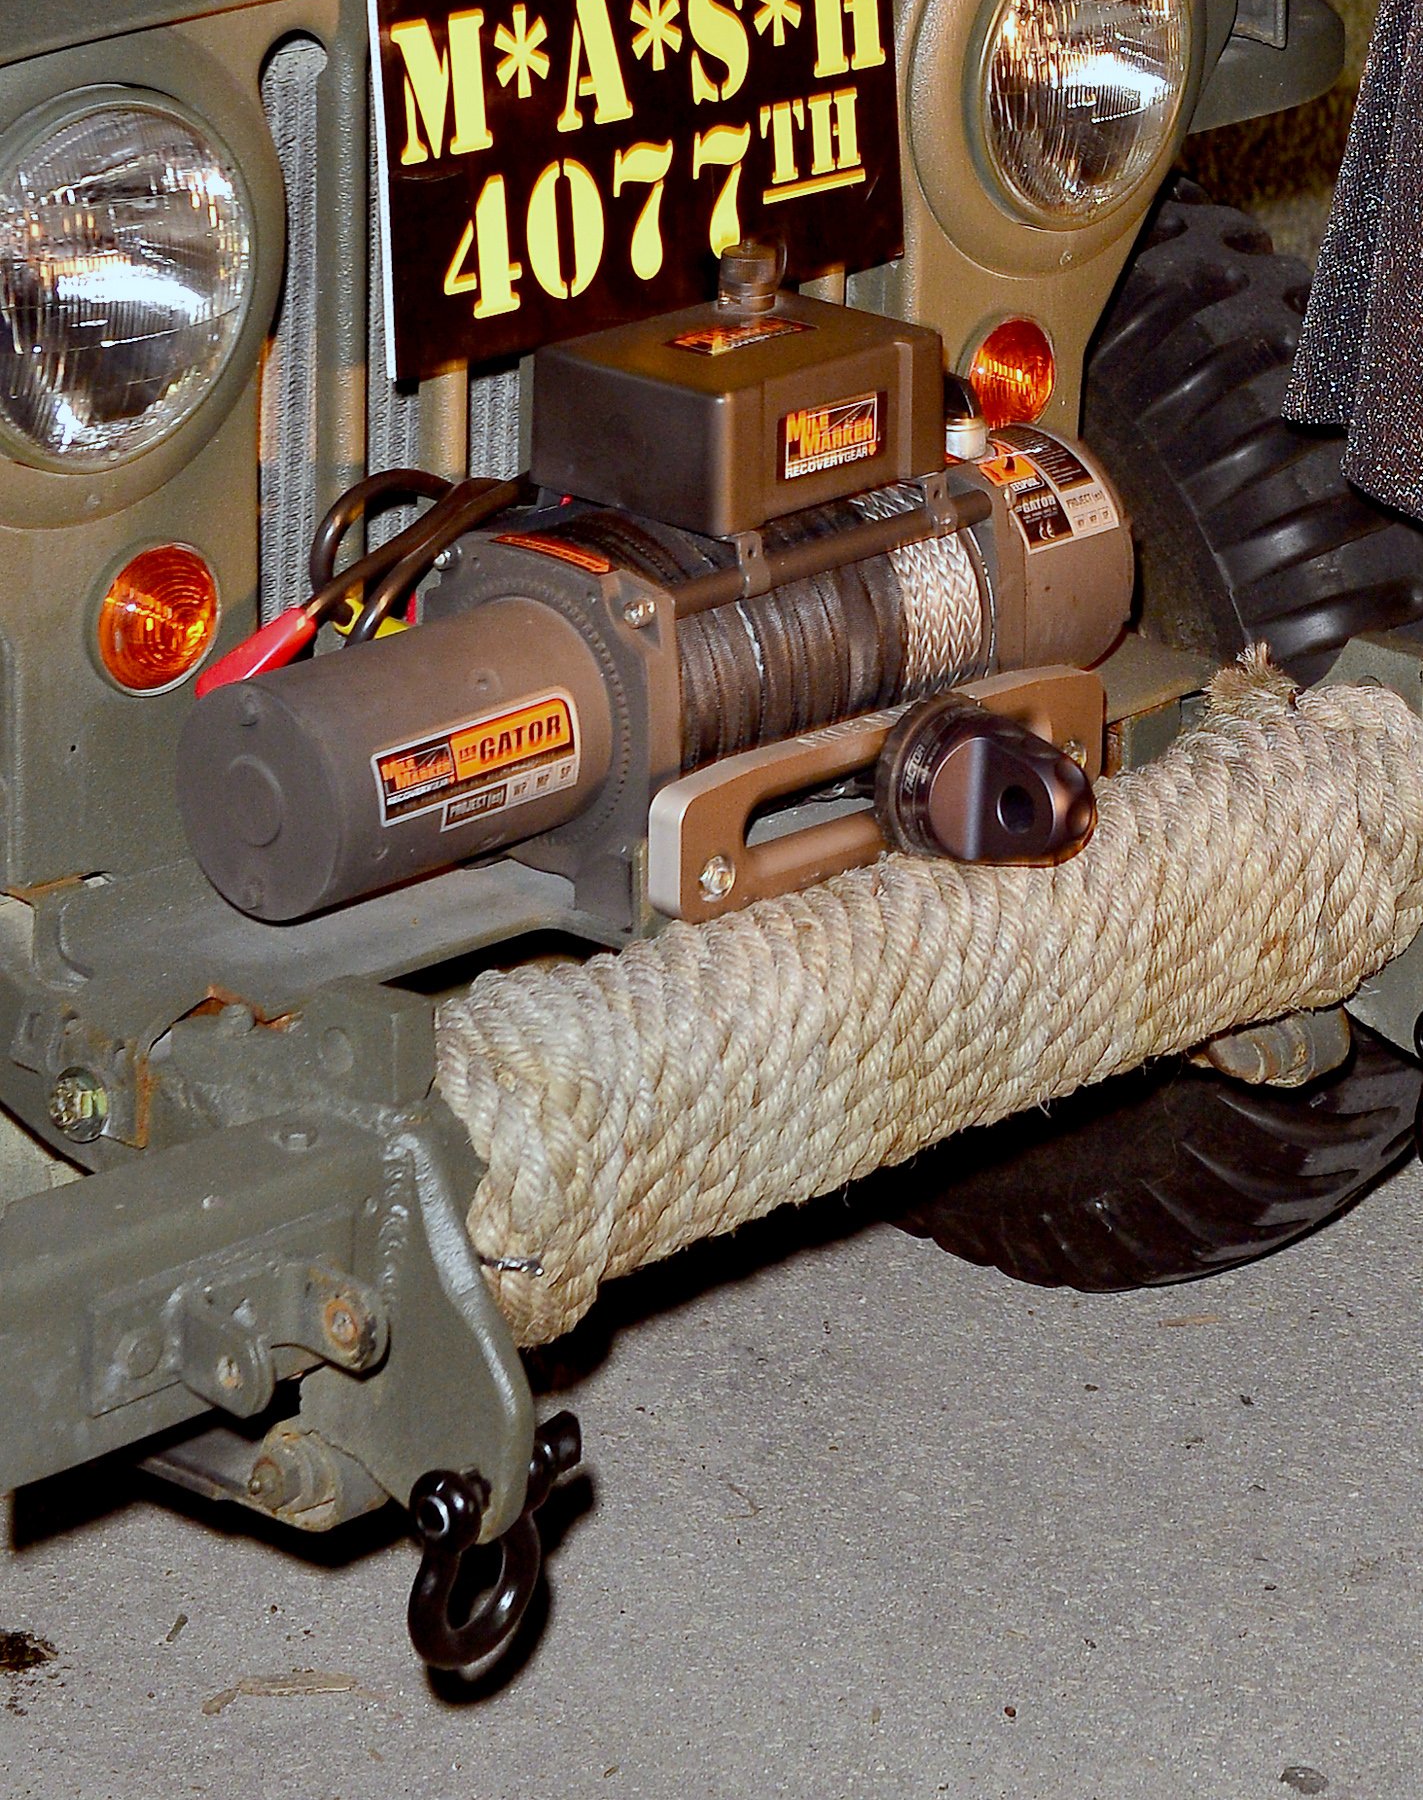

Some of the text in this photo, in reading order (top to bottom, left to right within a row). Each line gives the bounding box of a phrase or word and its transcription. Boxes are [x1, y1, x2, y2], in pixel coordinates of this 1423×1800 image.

[787, 409, 829, 444] MILE
[800, 418, 873, 459] MARKER
[479, 714, 561, 765] GATOR
